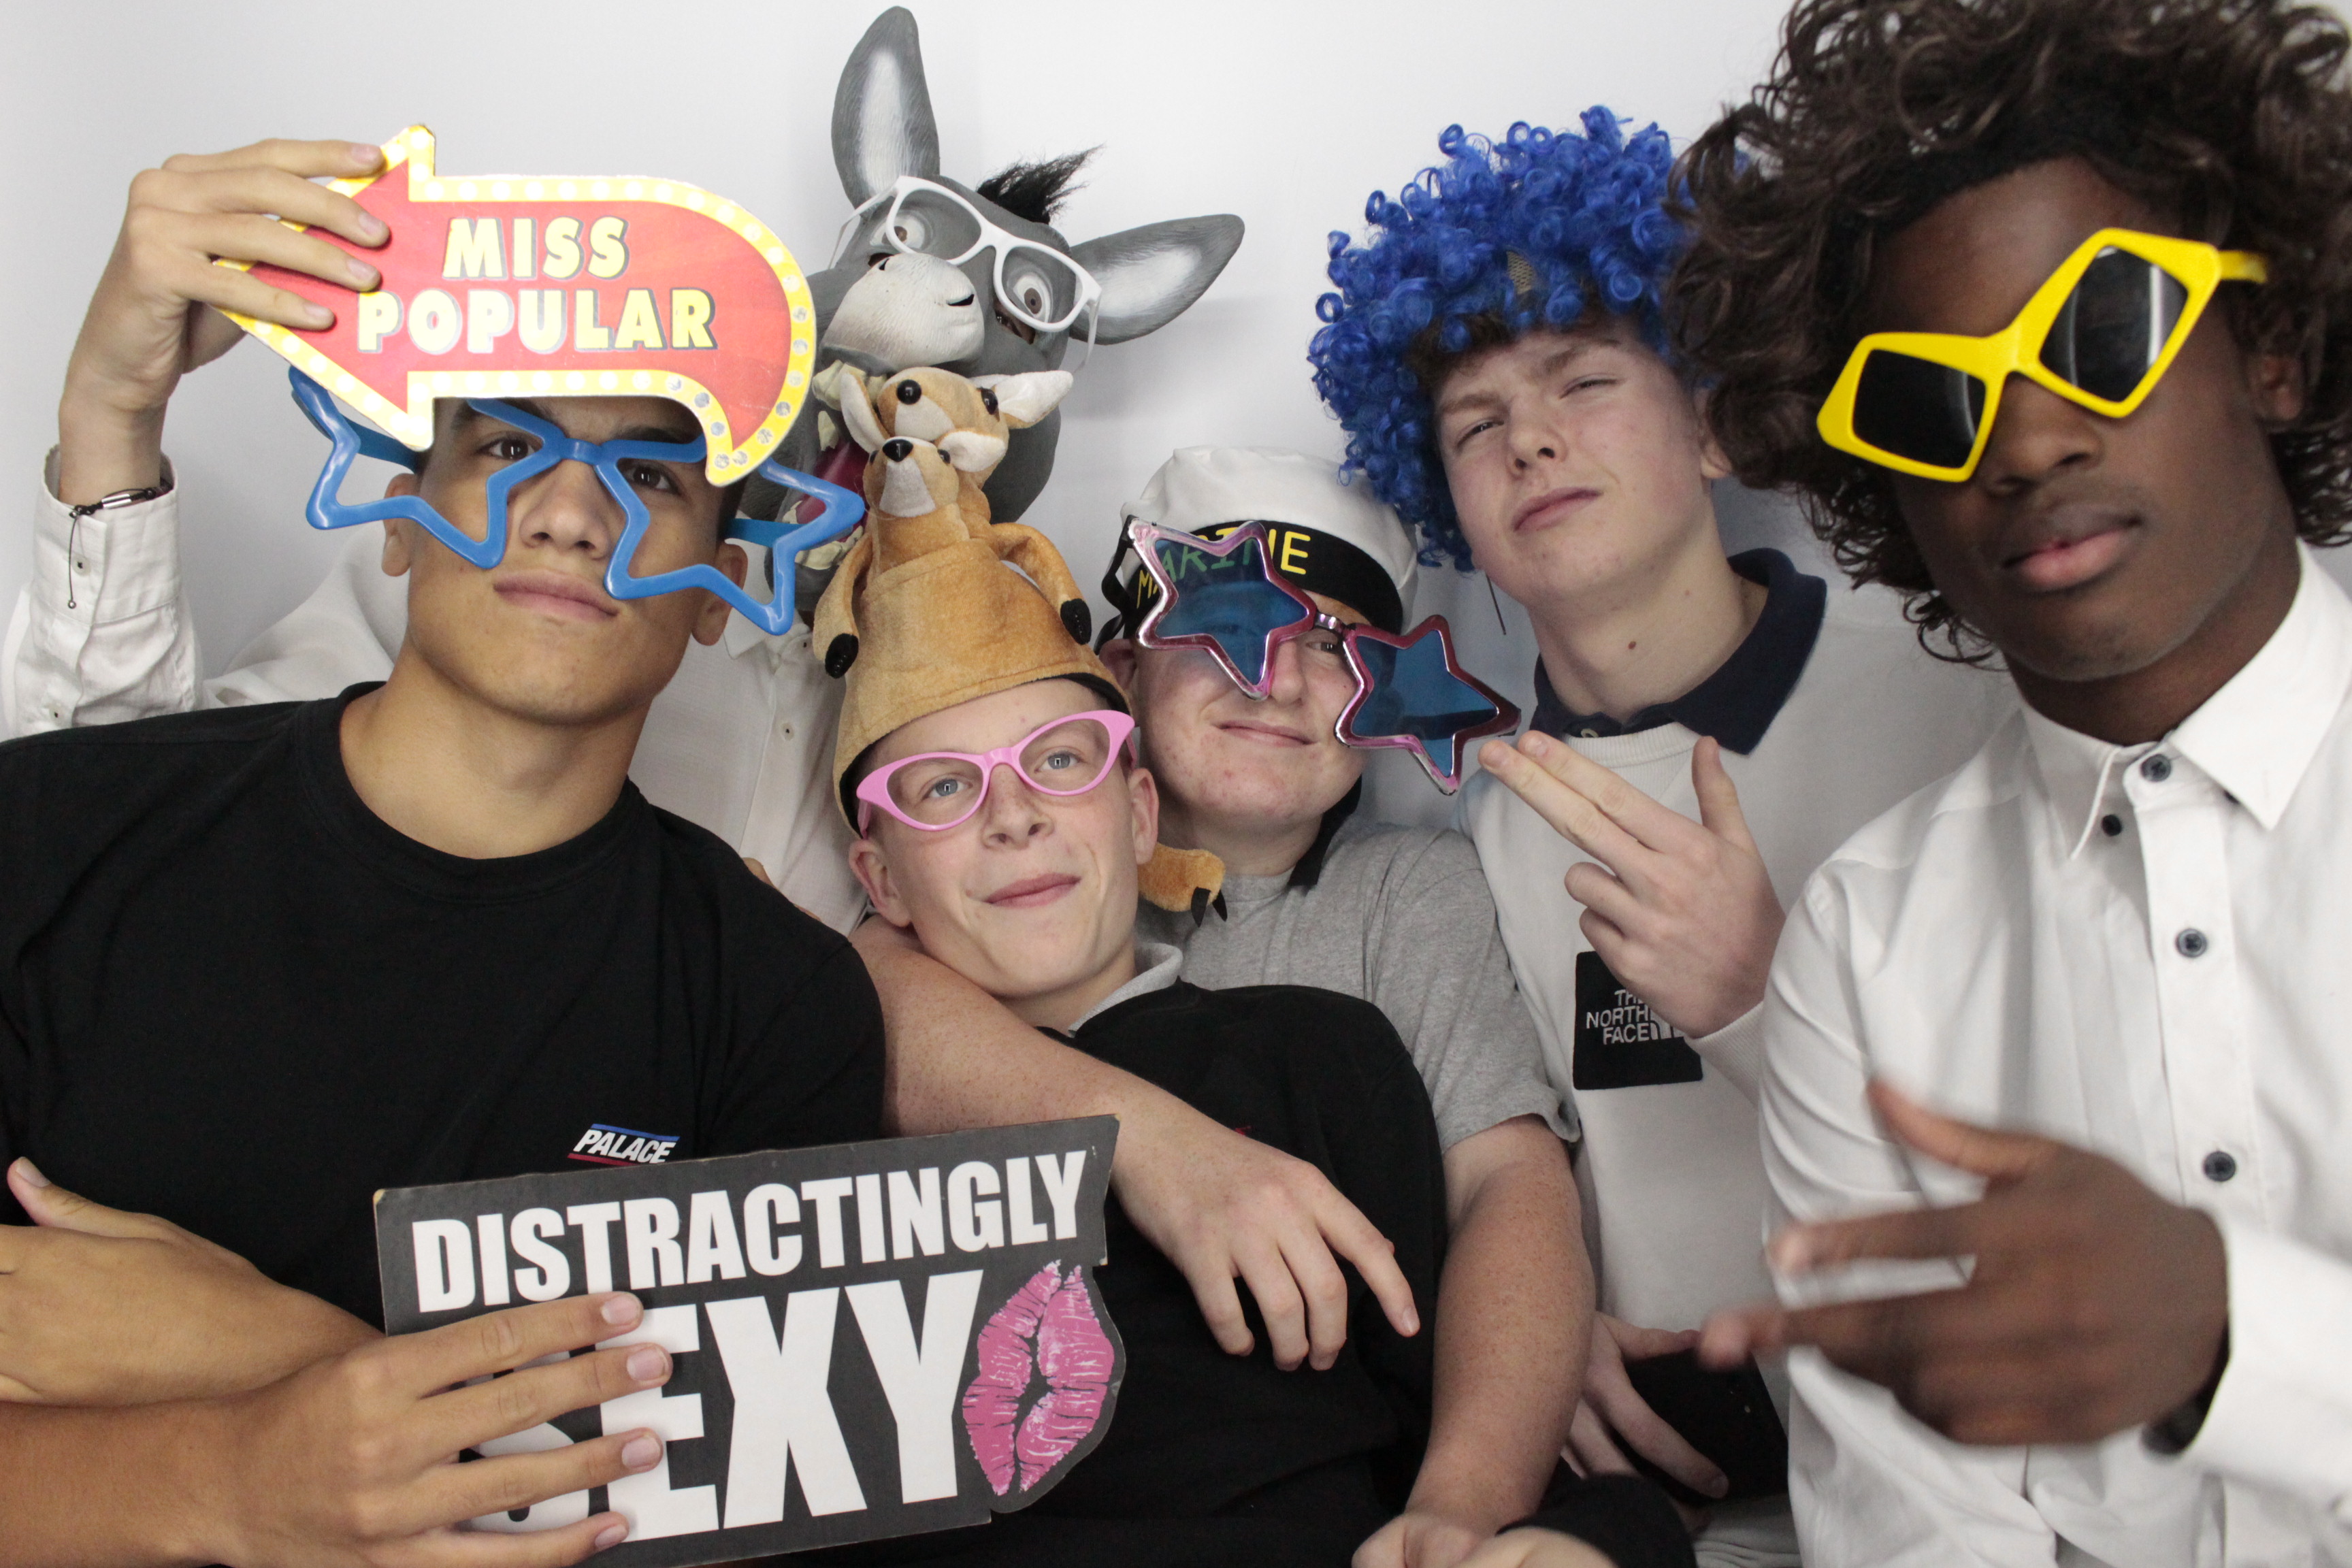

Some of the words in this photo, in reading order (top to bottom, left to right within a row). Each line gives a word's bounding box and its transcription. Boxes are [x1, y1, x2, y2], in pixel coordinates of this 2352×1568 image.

[442, 216, 629, 280] MISS
[357, 287, 717, 355] POPULAR
[1614, 989, 1644, 1007] TH
[1586, 1004, 1649, 1029] NORTH
[1603, 1022, 1650, 1045] FACE
[573, 1129, 676, 1164] PALACE
[411, 1149, 1088, 1313] DISTRACTINGLY
